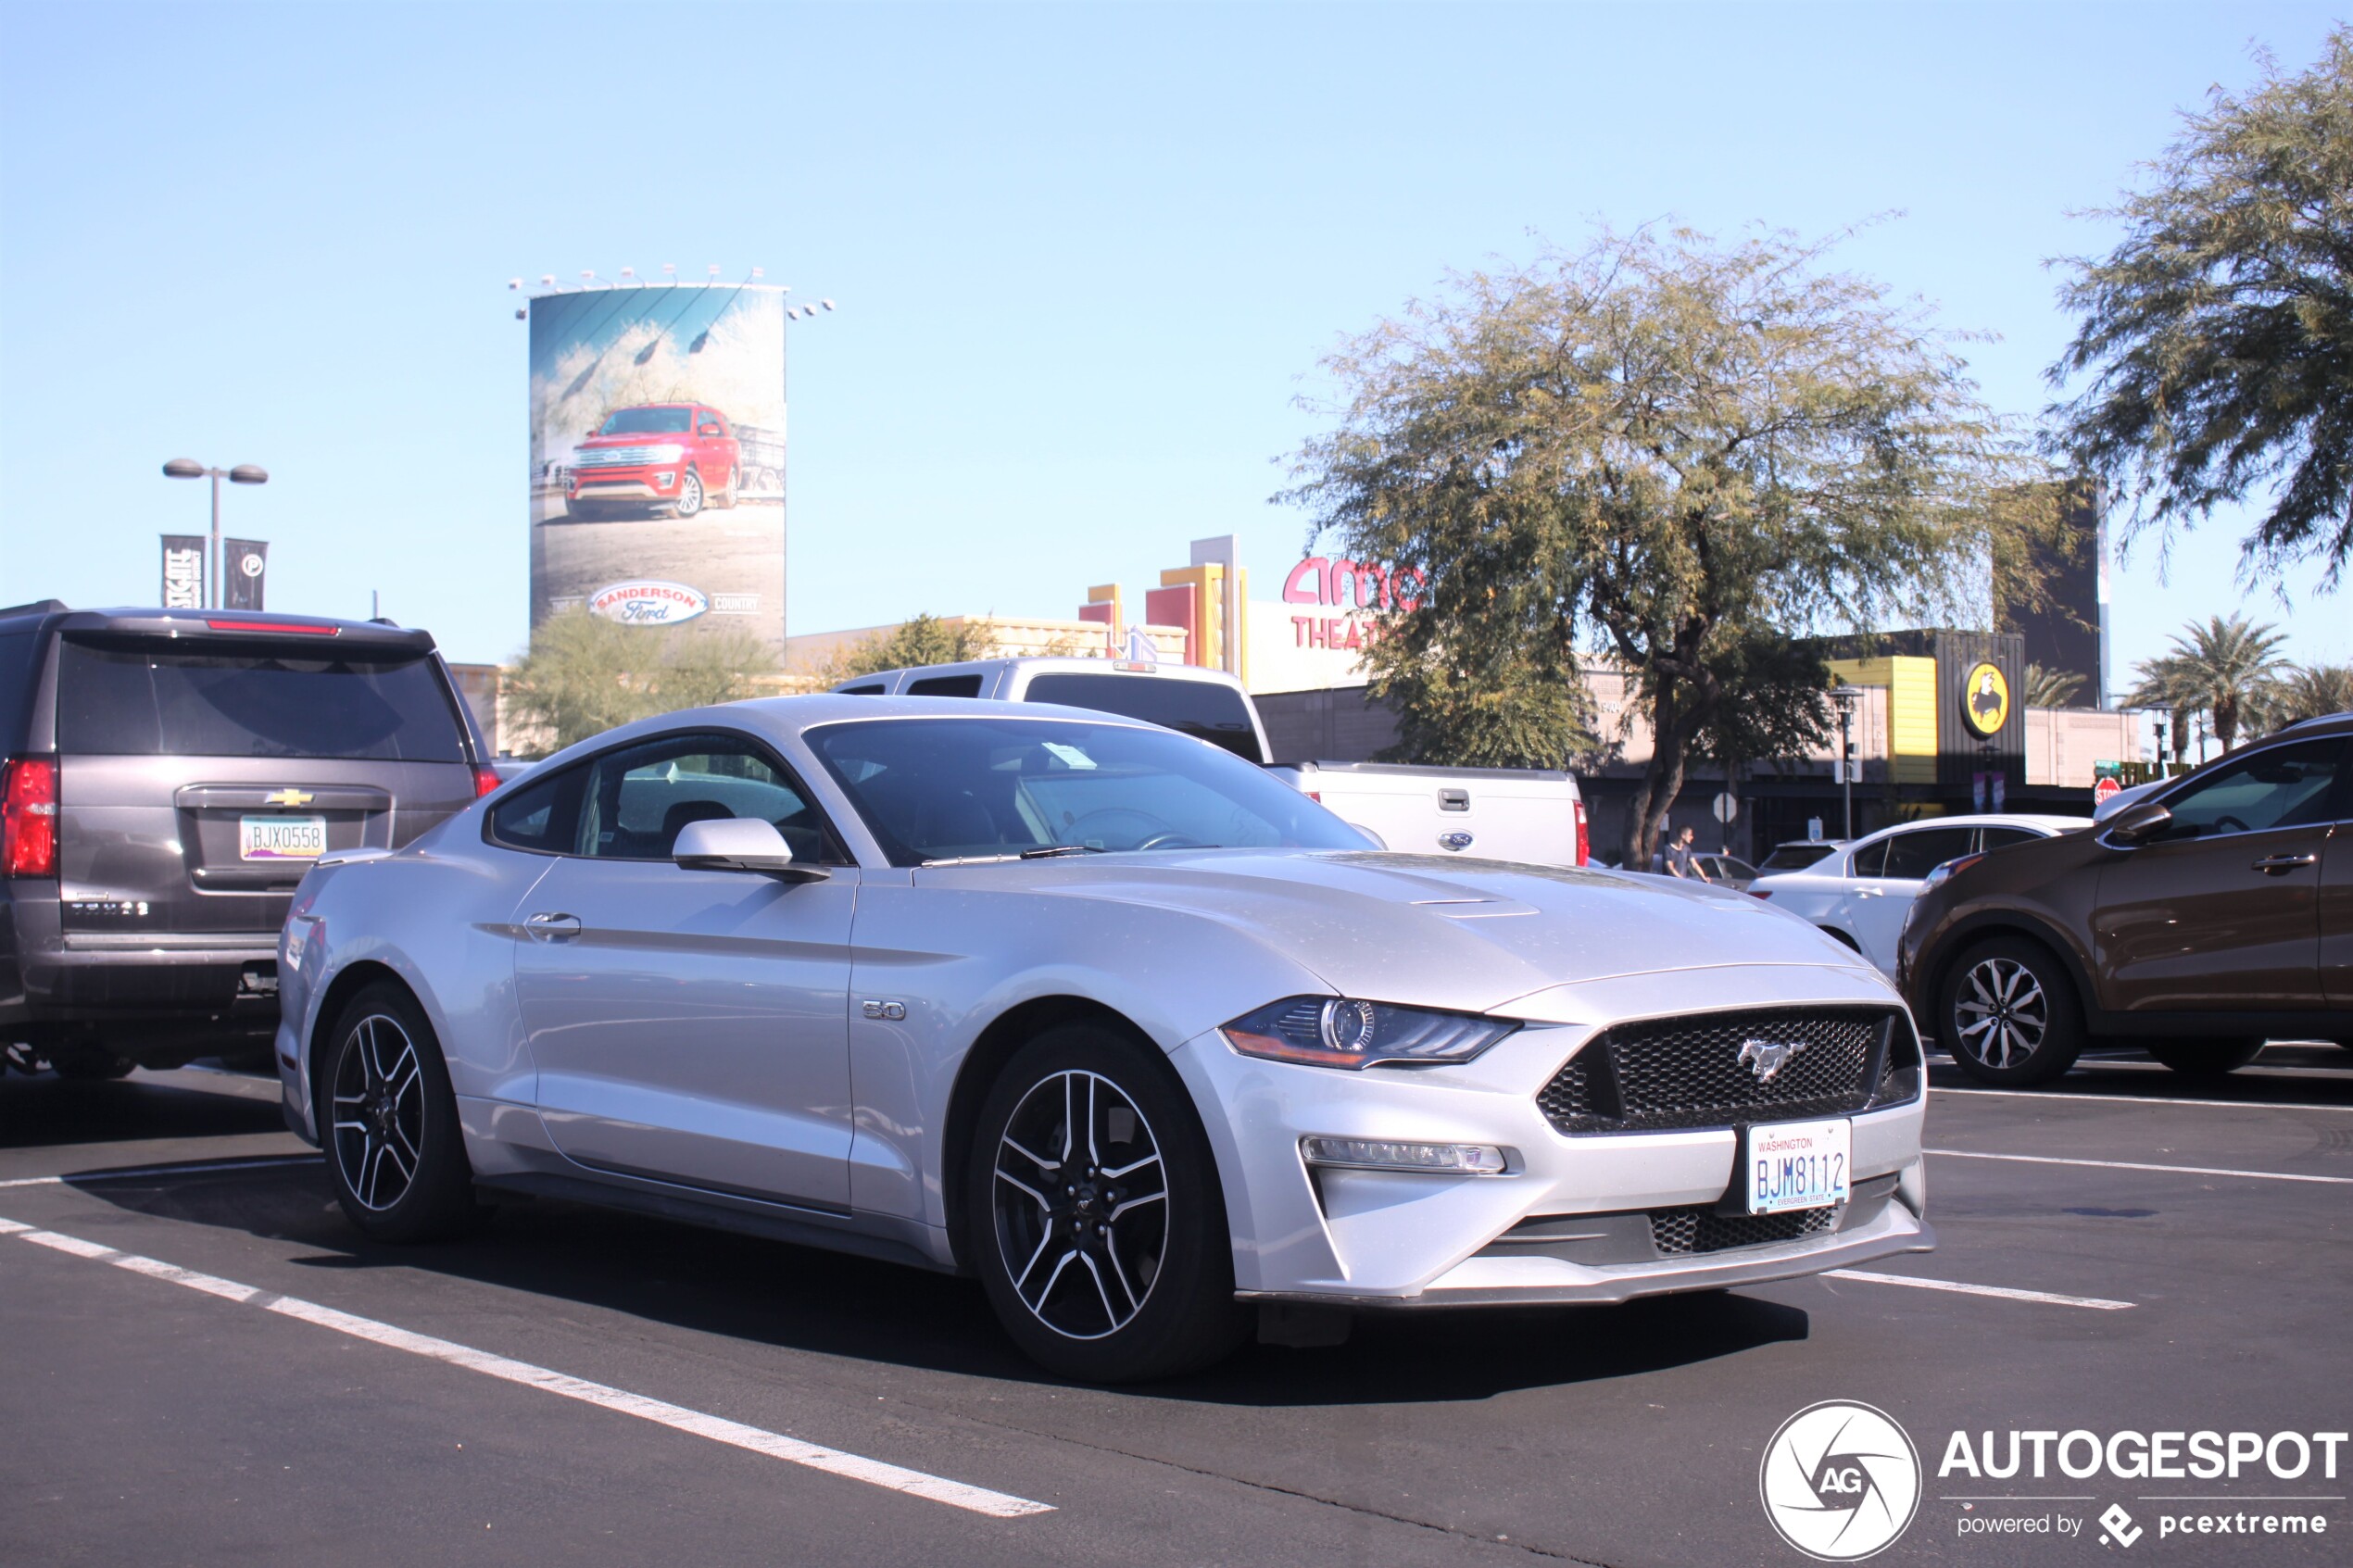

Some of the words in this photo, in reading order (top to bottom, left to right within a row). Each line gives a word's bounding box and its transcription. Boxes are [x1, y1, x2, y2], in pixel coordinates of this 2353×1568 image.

[596, 586, 697, 608] SANDERSON
[714, 596, 758, 611] COUNTRY
[621, 600, 668, 621] Ford
[253, 826, 321, 848] BJX0558
[1757, 1137, 1813, 1153] WASHINGTON
[1756, 1152, 1844, 1199] BJM8112
[1777, 1195, 1807, 1206] EVERGREEN
[1809, 1193, 1825, 1202] STATE
